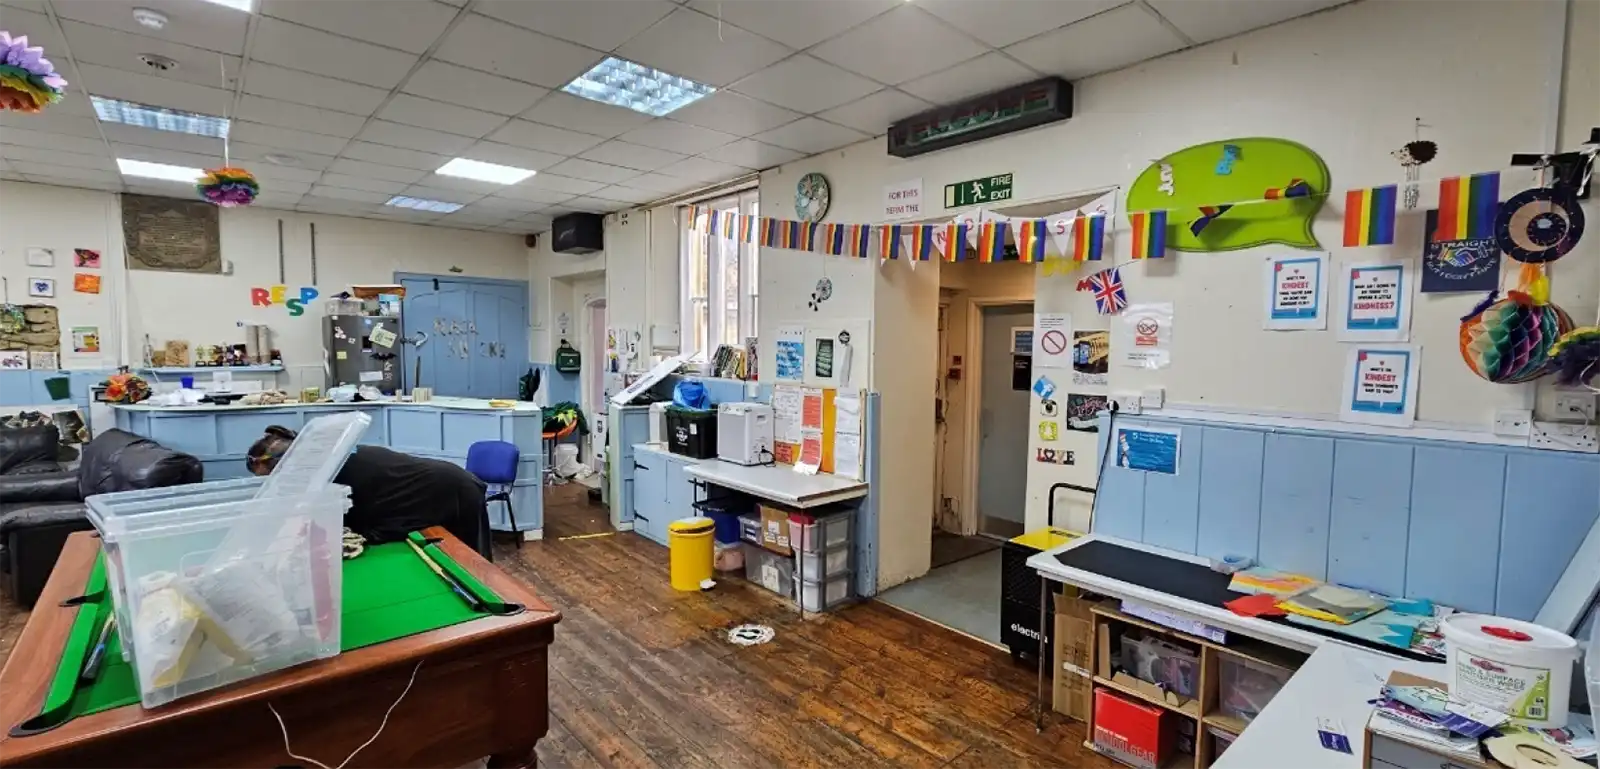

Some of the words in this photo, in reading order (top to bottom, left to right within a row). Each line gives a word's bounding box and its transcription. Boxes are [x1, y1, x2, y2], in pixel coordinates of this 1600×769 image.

[990, 175, 1012, 186] FIRE
[888, 191, 902, 200] FOR
[990, 188, 1011, 200] EXIT
[905, 204, 919, 213] THE
[1354, 301, 1395, 310] KINDNESS?
[1365, 373, 1397, 382] KINDEST
[1036, 447, 1075, 466] LOVE
